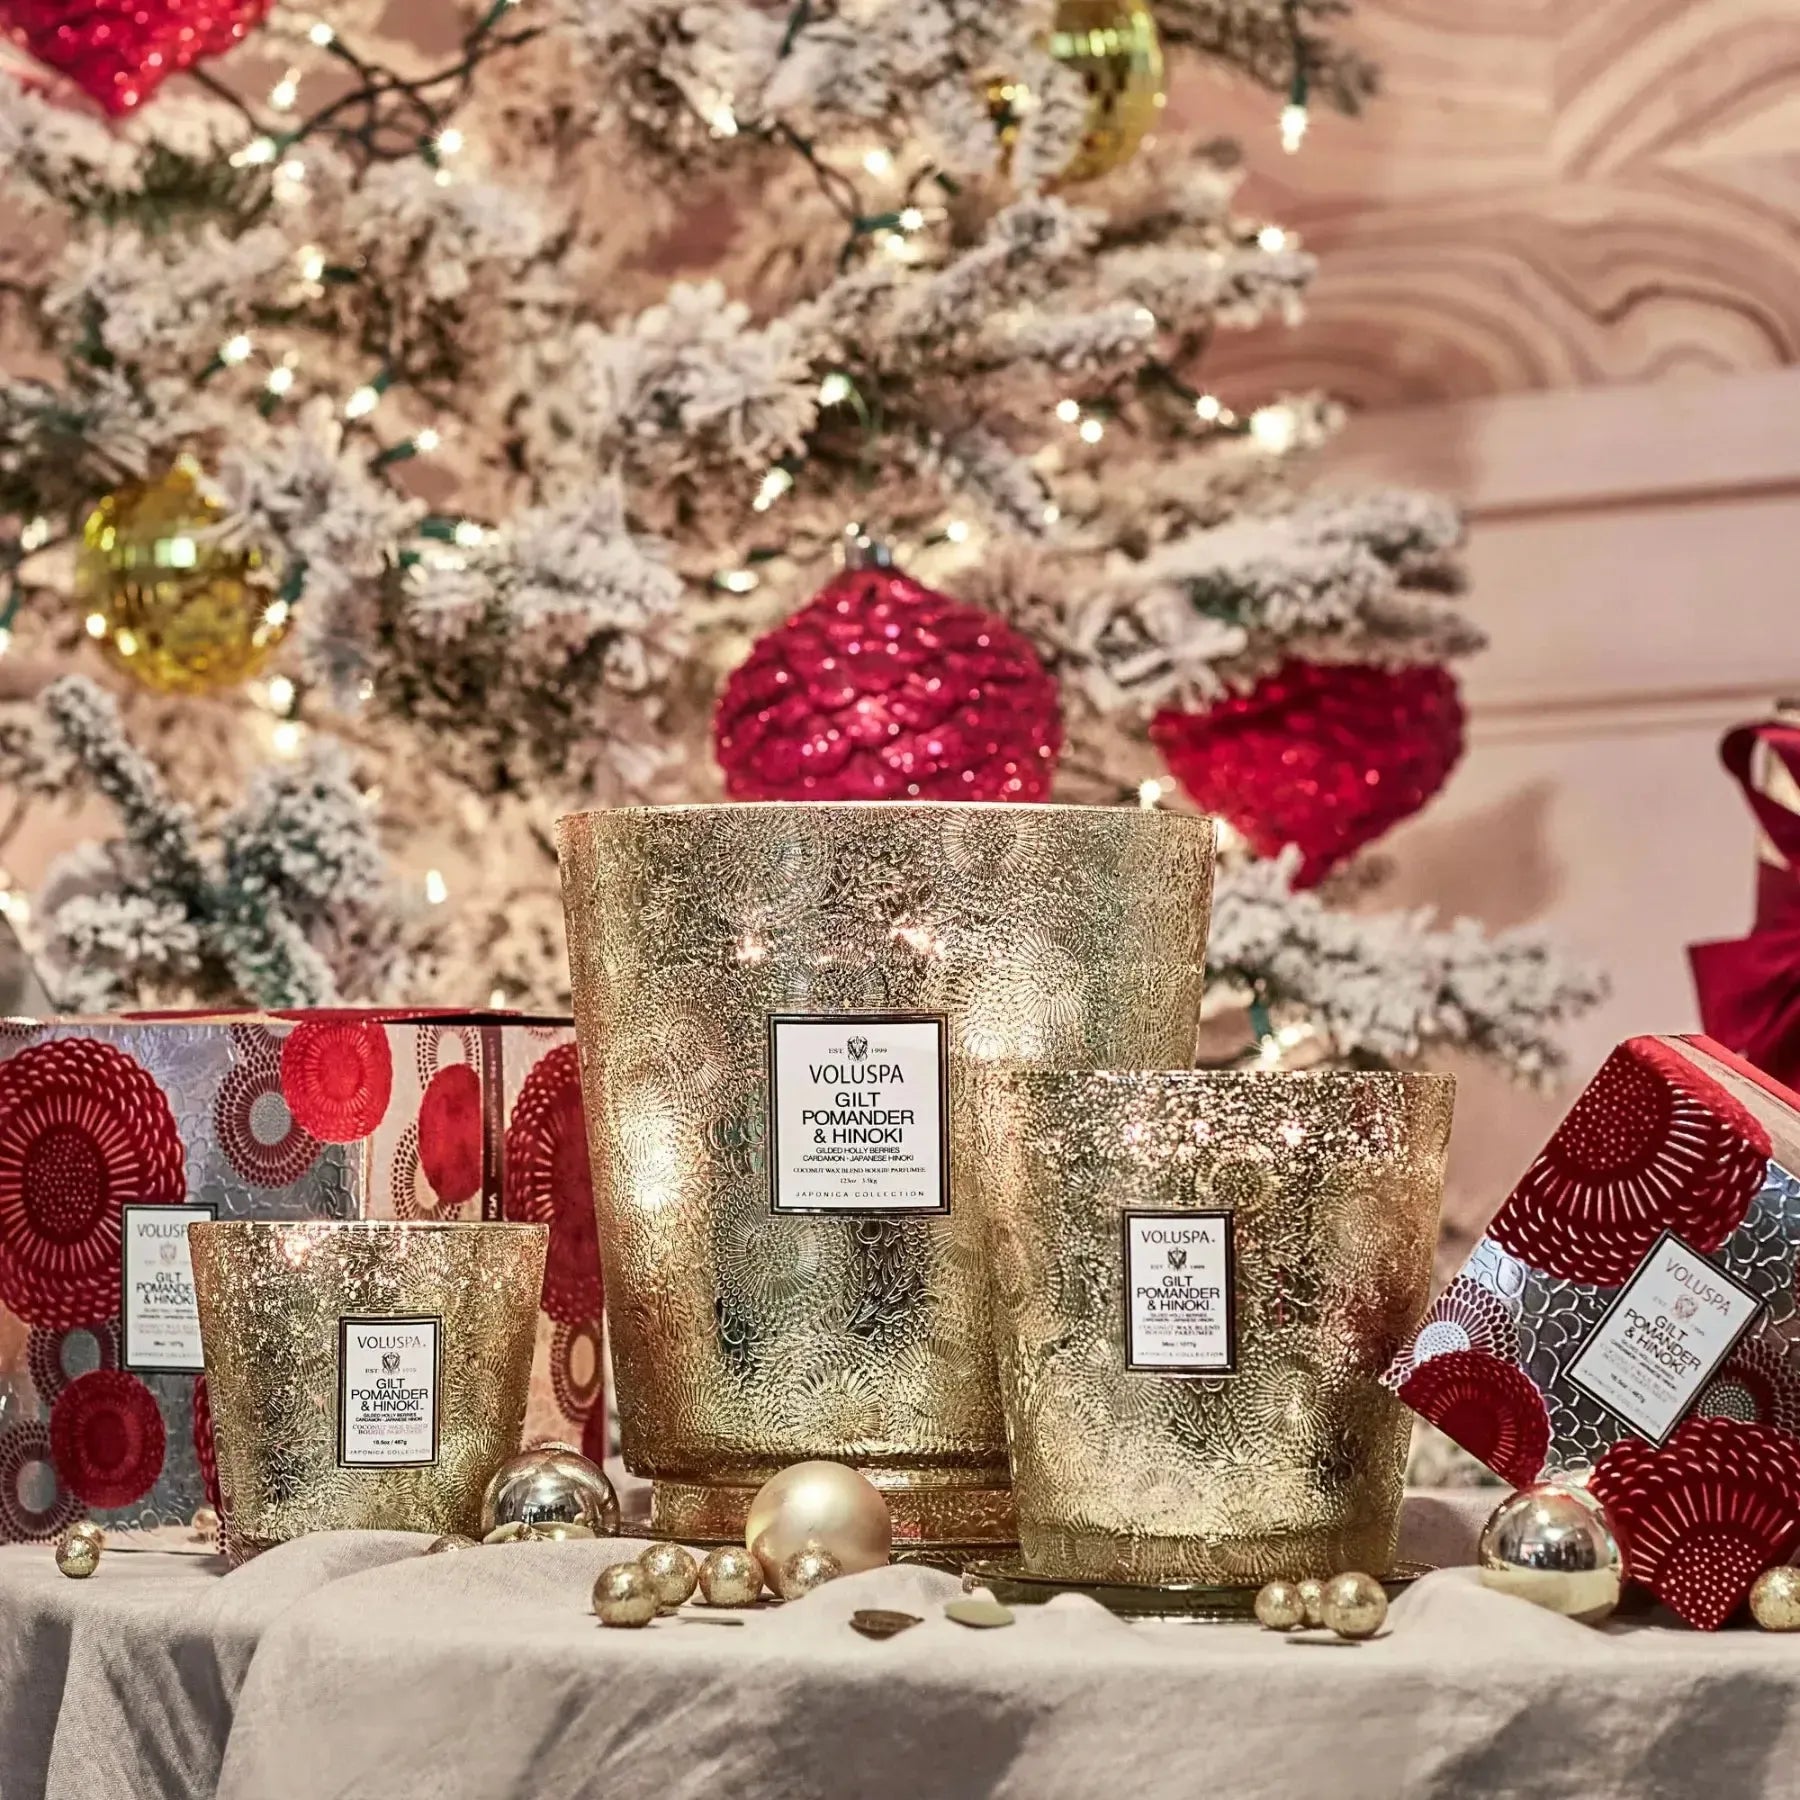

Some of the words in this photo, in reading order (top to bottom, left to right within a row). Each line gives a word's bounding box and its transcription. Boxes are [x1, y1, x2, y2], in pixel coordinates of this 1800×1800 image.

[809, 1064, 904, 1084] VOLUSPA
[835, 1092, 881, 1108] GILT
[802, 1110, 914, 1125] POMANDER
[813, 1128, 827, 1144] &
[832, 1128, 903, 1143] HINOKI
[802, 1154, 846, 1162] CARDAMON
[850, 1154, 887, 1162] JAPANESE
[888, 1154, 914, 1162] HINOKI
[156, 1272, 182, 1282] GILT
[1162, 1276, 1194, 1287] GILT
[1666, 1258, 1732, 1316] VOLUSPA
[1137, 1288, 1220, 1299] POMANDER
[1147, 1300, 1156, 1311] &
[1624, 1326, 1634, 1340] &
[1654, 1315, 1688, 1342] GILT
[1624, 1308, 1702, 1371] POMANDER
[376, 1378, 406, 1389] GILT
[351, 1389, 429, 1400] POMANDER
[360, 1401, 370, 1411] &
